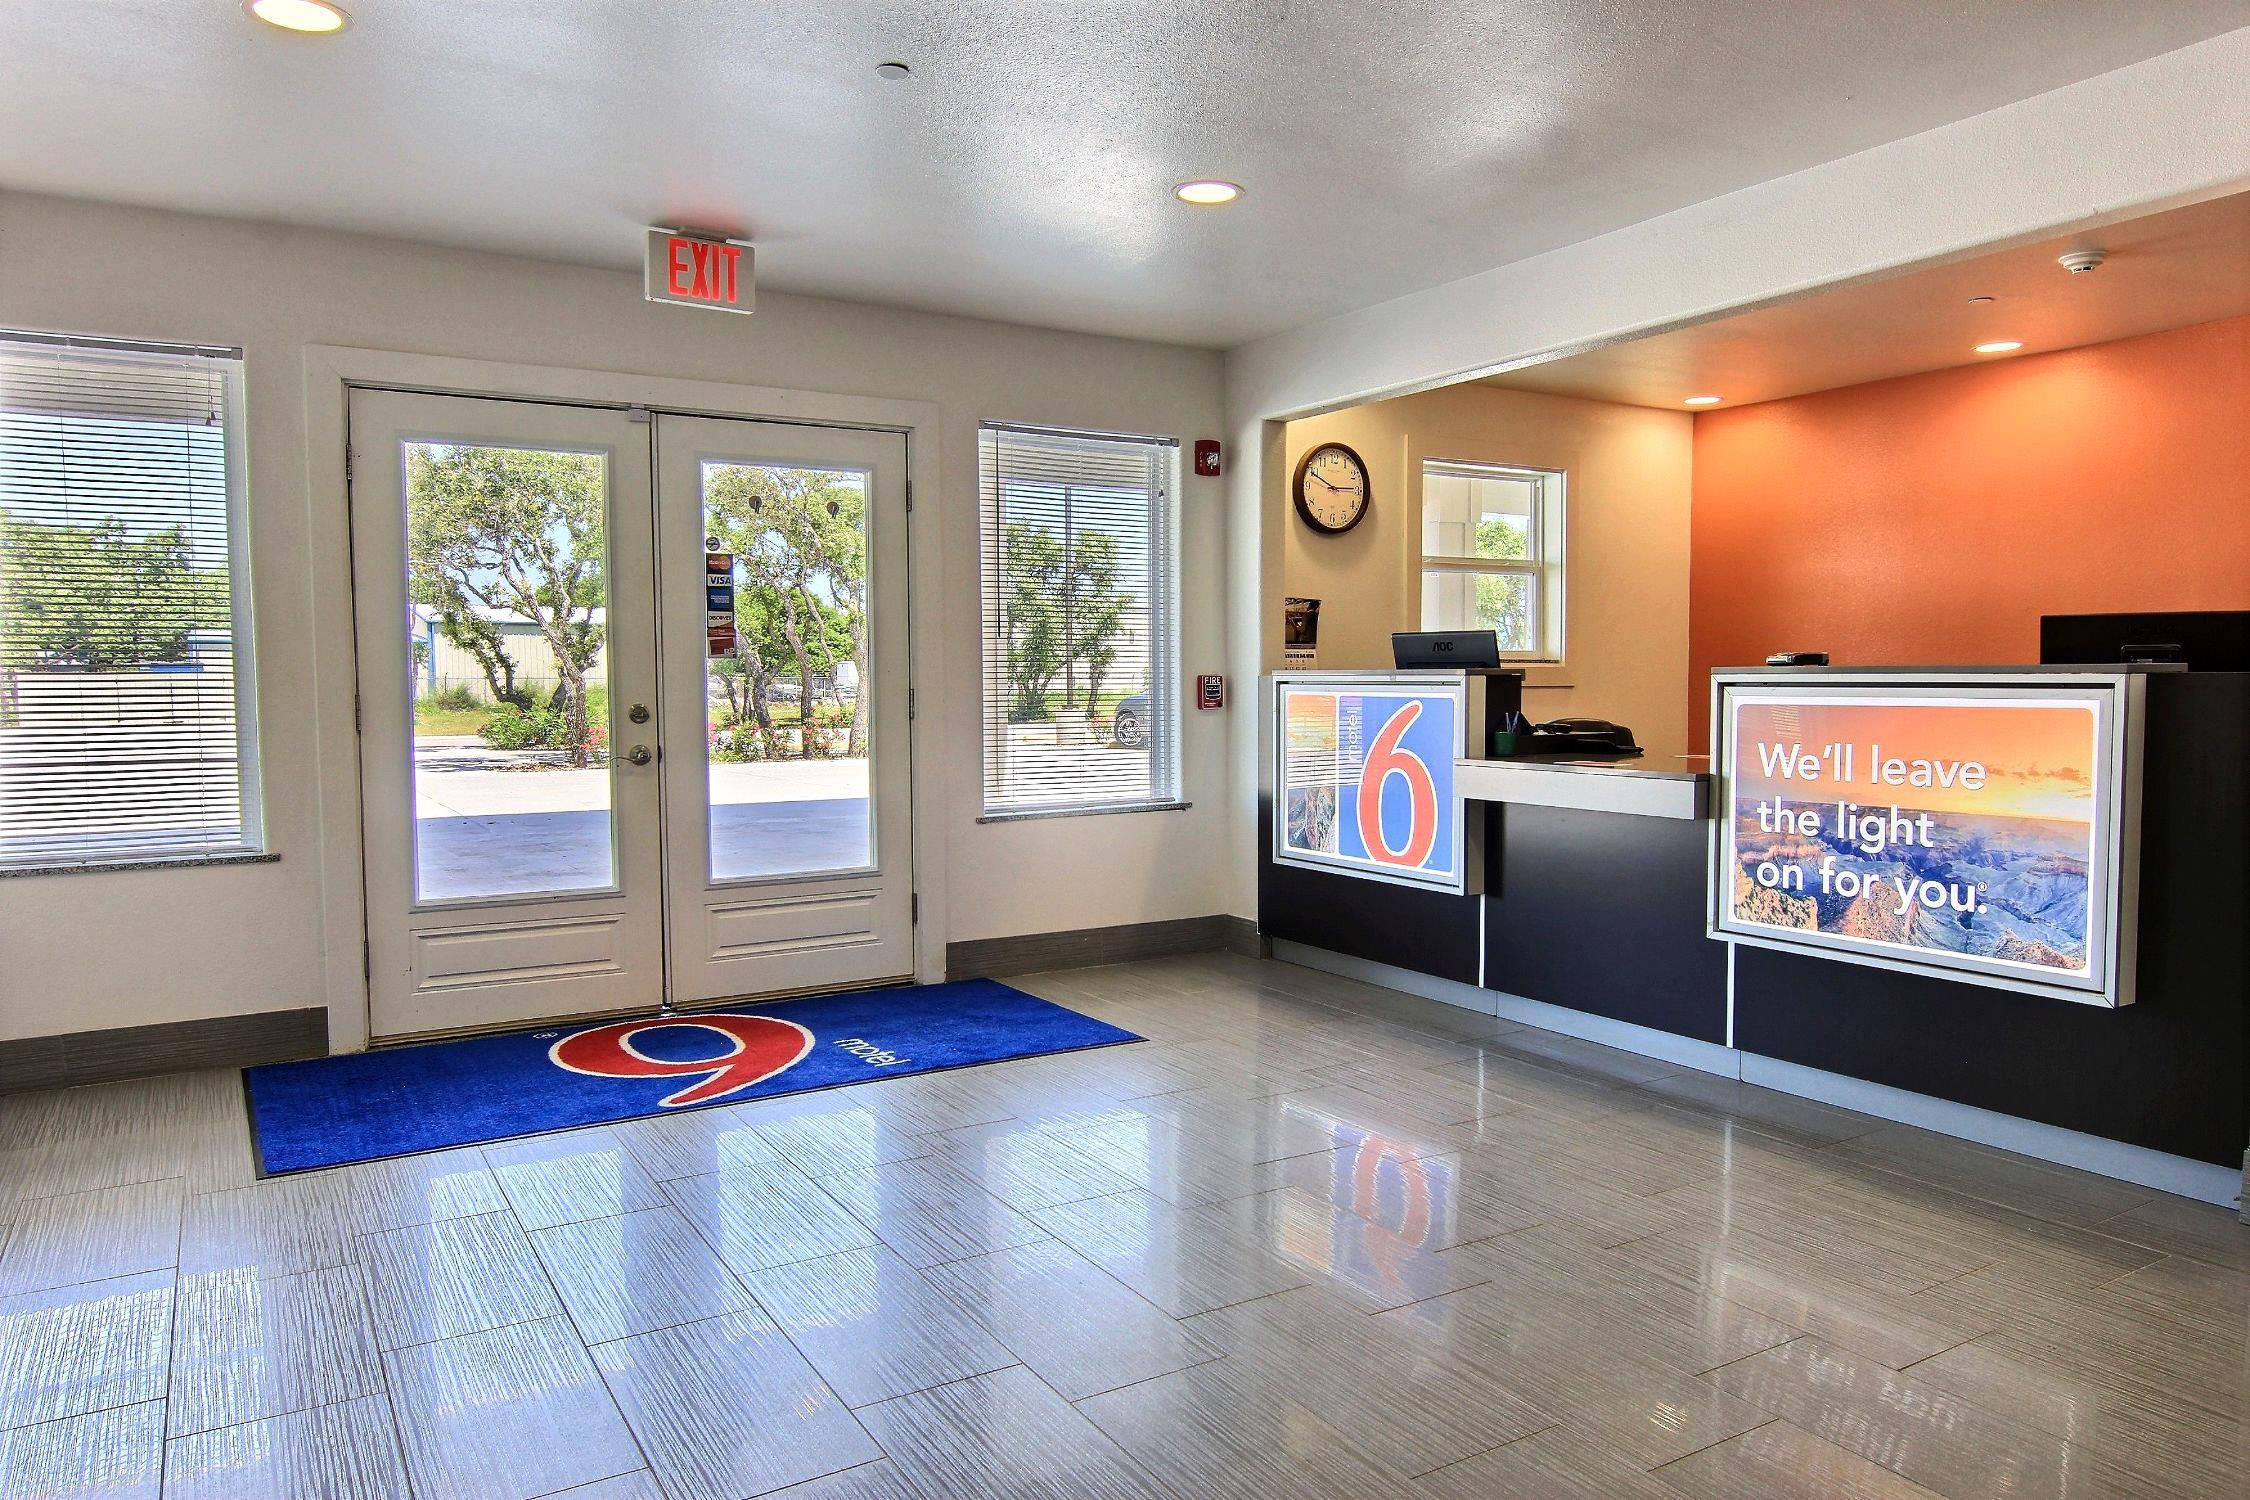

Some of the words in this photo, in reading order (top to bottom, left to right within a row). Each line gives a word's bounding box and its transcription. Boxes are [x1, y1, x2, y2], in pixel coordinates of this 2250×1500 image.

[667, 237, 743, 304] EXIT
[1319, 457, 1326, 467] 11
[1330, 454, 1339, 464] 12
[1343, 459, 1347, 469] 1
[1350, 469, 1356, 480] 2
[1305, 481, 1311, 490] 9
[1354, 486, 1360, 495] 3
[1308, 498, 1315, 506] 8
[1349, 500, 1355, 509] 4
[1317, 508, 1323, 519] 7
[1329, 513, 1336, 523] 6
[1340, 510, 1347, 520] 5
[710, 576, 731, 585] VISA
[1433, 642, 1454, 652] AOC
[1204, 676, 1221, 684] FIRE
[1757, 742, 1854, 783] We'll
[1871, 744, 1986, 790] leave
[1356, 700, 1439, 868] 6
[1756, 796, 1821, 836] the
[1837, 800, 1935, 854] light
[1756, 861, 1804, 890] on
[1819, 856, 1880, 899] for
[832, 1039, 911, 1067] motel
